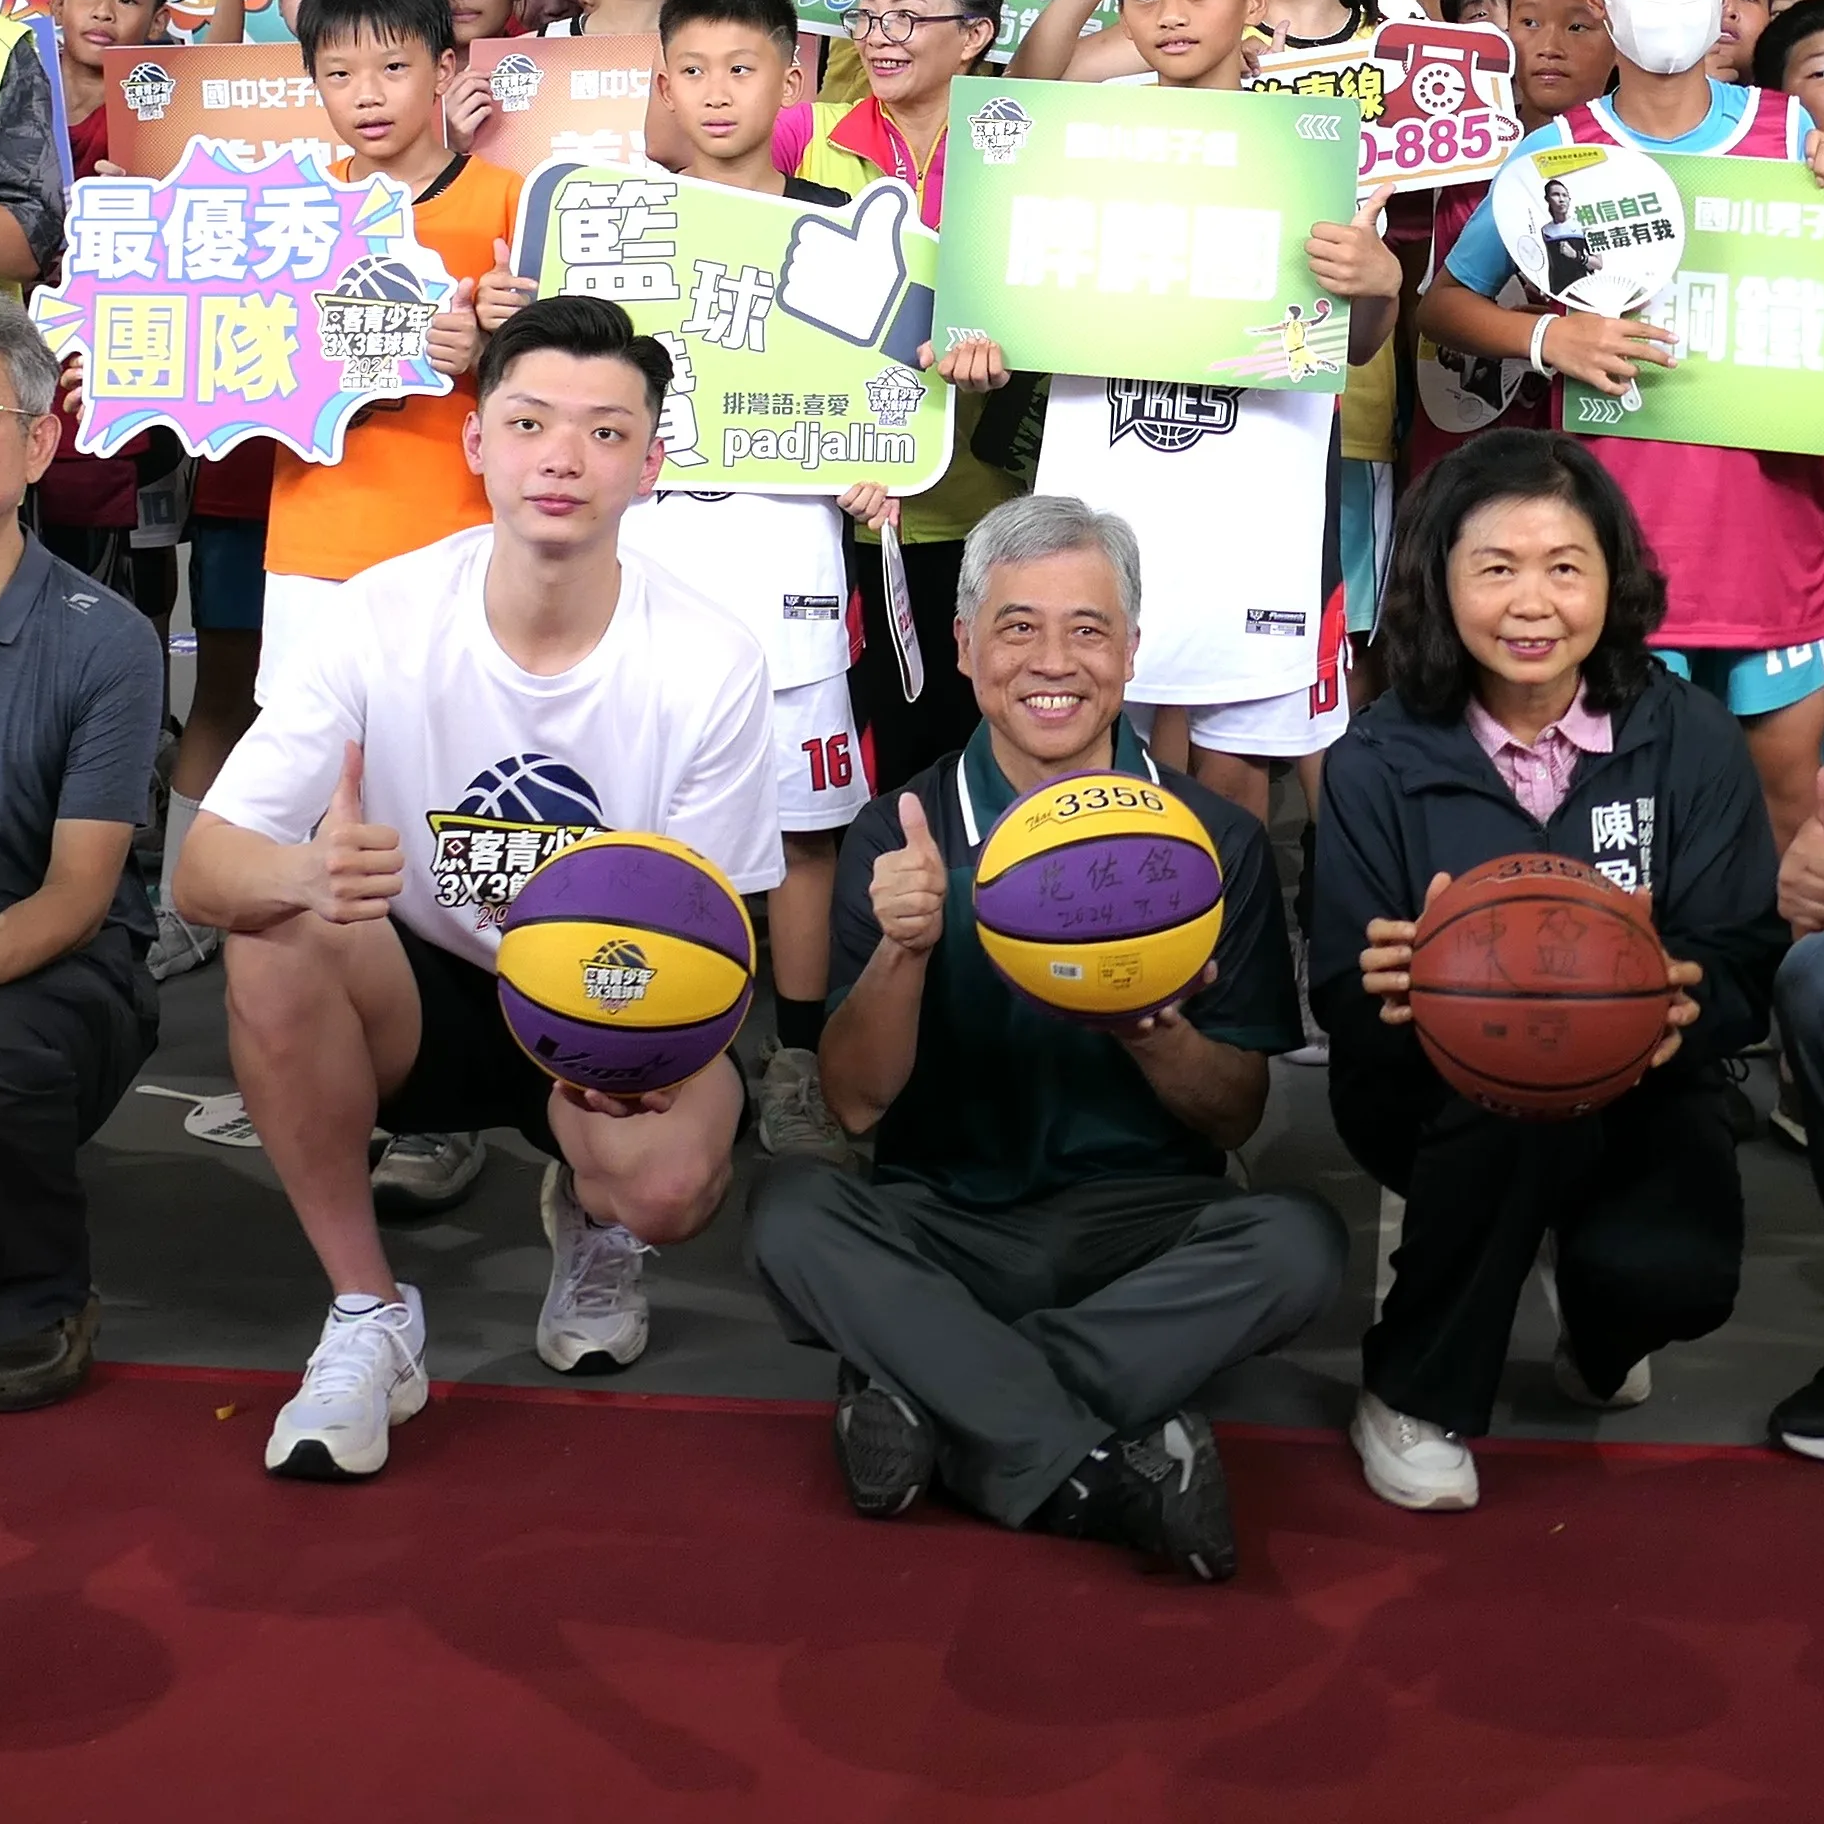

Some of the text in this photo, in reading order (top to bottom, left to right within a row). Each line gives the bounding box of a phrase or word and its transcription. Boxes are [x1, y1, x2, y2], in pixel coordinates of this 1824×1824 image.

[202, 78, 323, 110] 國中女子
[1574, 192, 1662, 226] 相信自己
[75, 185, 341, 281] 最優秀
[1587, 219, 1675, 252] 無毒有我
[90, 294, 300, 403] 團隊
[347, 358, 395, 376] 2024
[723, 423, 915, 469] padjalim
[801, 732, 852, 791] 16
[1055, 786, 1165, 817] 3356
[432, 827, 604, 874] 原客青少
